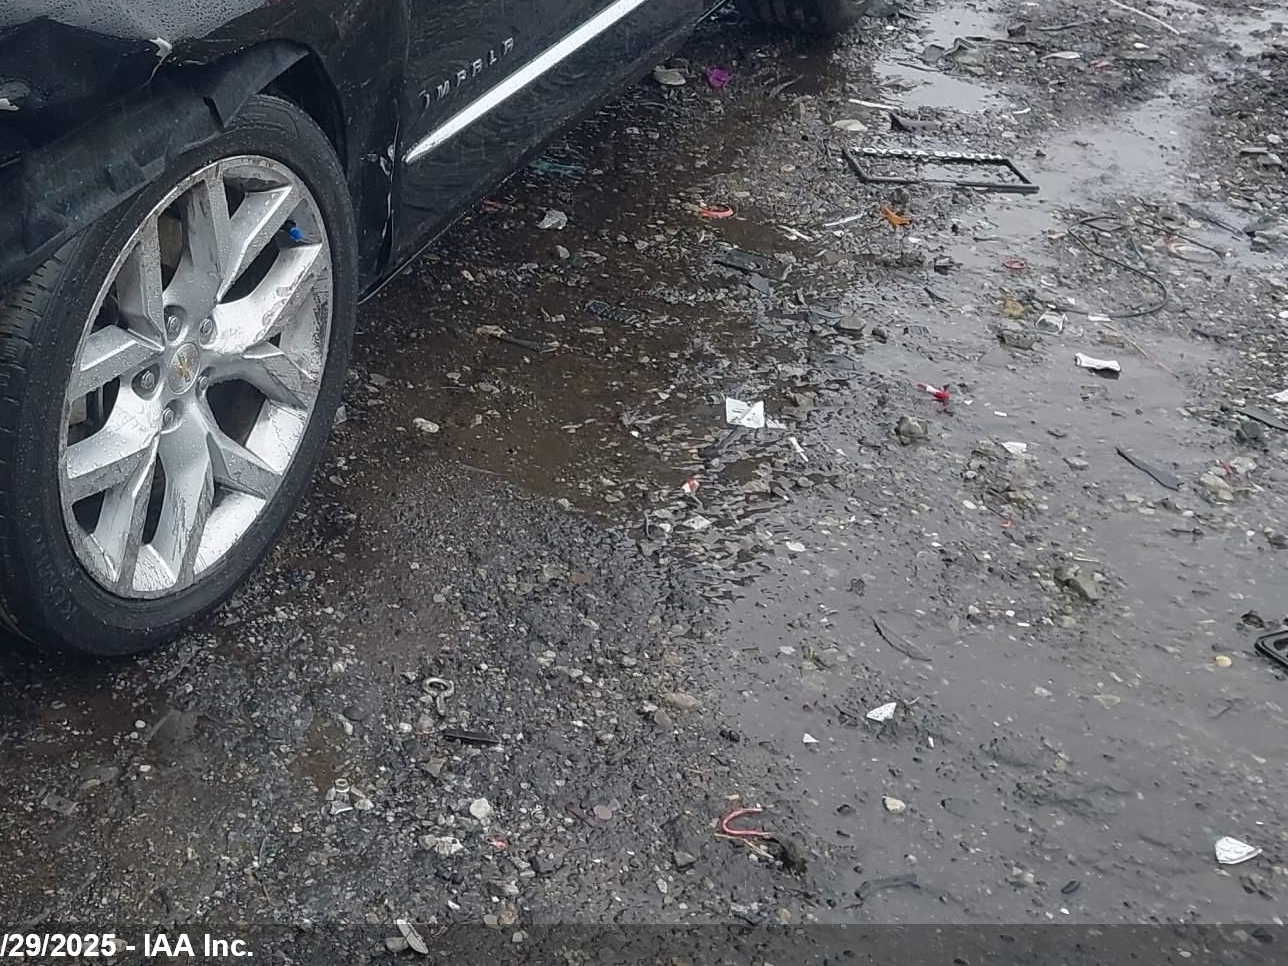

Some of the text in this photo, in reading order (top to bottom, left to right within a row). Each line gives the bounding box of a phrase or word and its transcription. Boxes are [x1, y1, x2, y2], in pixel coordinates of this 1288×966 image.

[417, 37, 514, 109] IMPALA
[852, 146, 1003, 160] TOYOTA SOUTH
